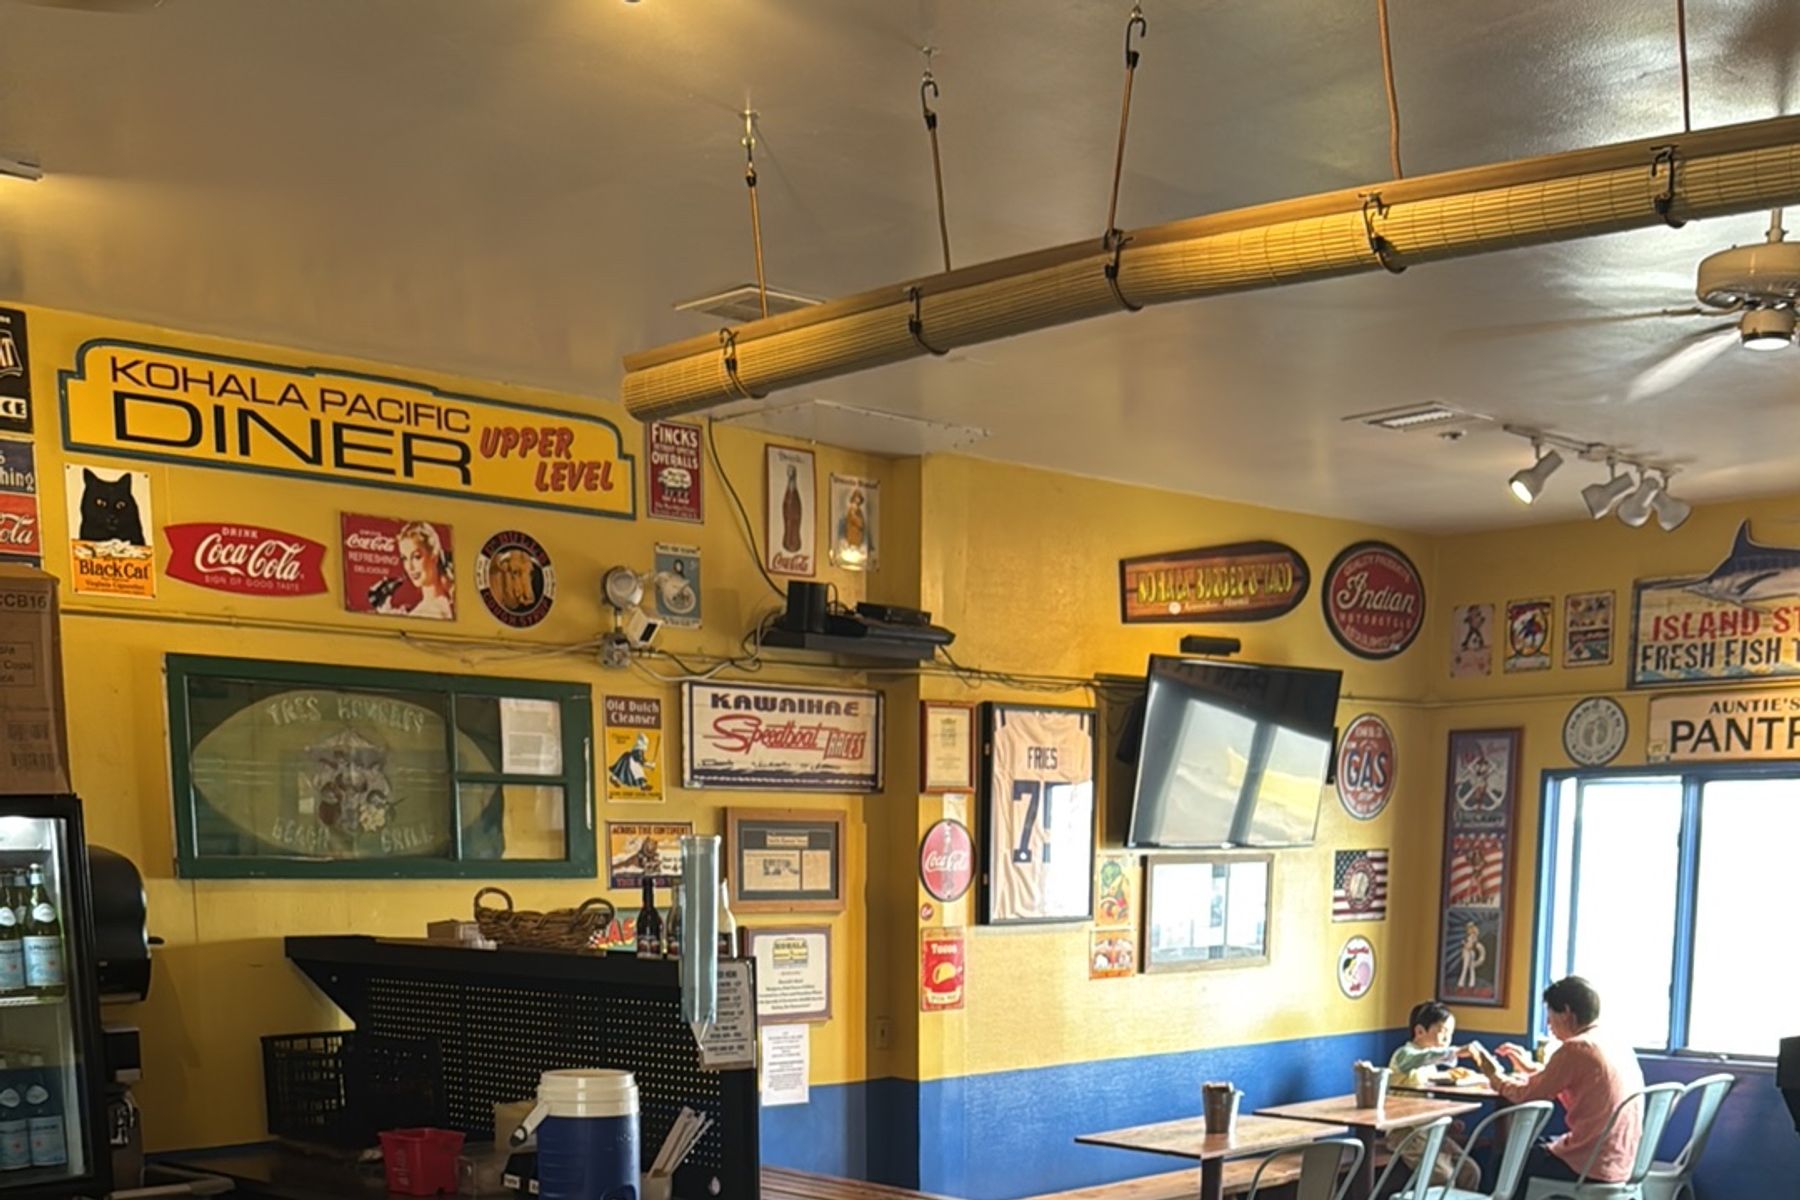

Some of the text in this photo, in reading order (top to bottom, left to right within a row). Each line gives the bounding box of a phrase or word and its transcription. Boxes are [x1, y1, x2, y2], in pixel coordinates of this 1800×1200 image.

[111, 356, 470, 434] KOHALA PACIFIC
[113, 390, 472, 486] DINER
[479, 426, 575, 460] UPPER
[651, 450, 698, 470] OVERALLS
[535, 461, 614, 492] LEVEL
[0, 512, 36, 545] ola
[221, 526, 259, 539] DRINK
[79, 558, 149, 580] Black Cat
[194, 533, 306, 581] Coca-Cola
[245, 577, 274, 590] GOOD
[1336, 571, 1415, 613] Indian
[1652, 607, 1760, 642] ISLAND
[1641, 641, 1717, 672] FRESH
[1724, 637, 1783, 667] FISH
[606, 698, 660, 714] Old Dutch
[610, 711, 657, 725] Cleanser
[711, 692, 860, 717] KAWAIHAE
[1709, 697, 1800, 715] AUNTIE'S
[711, 713, 824, 755] Speedboat
[1027, 746, 1058, 770] FRIES
[1344, 751, 1388, 792] GAS
